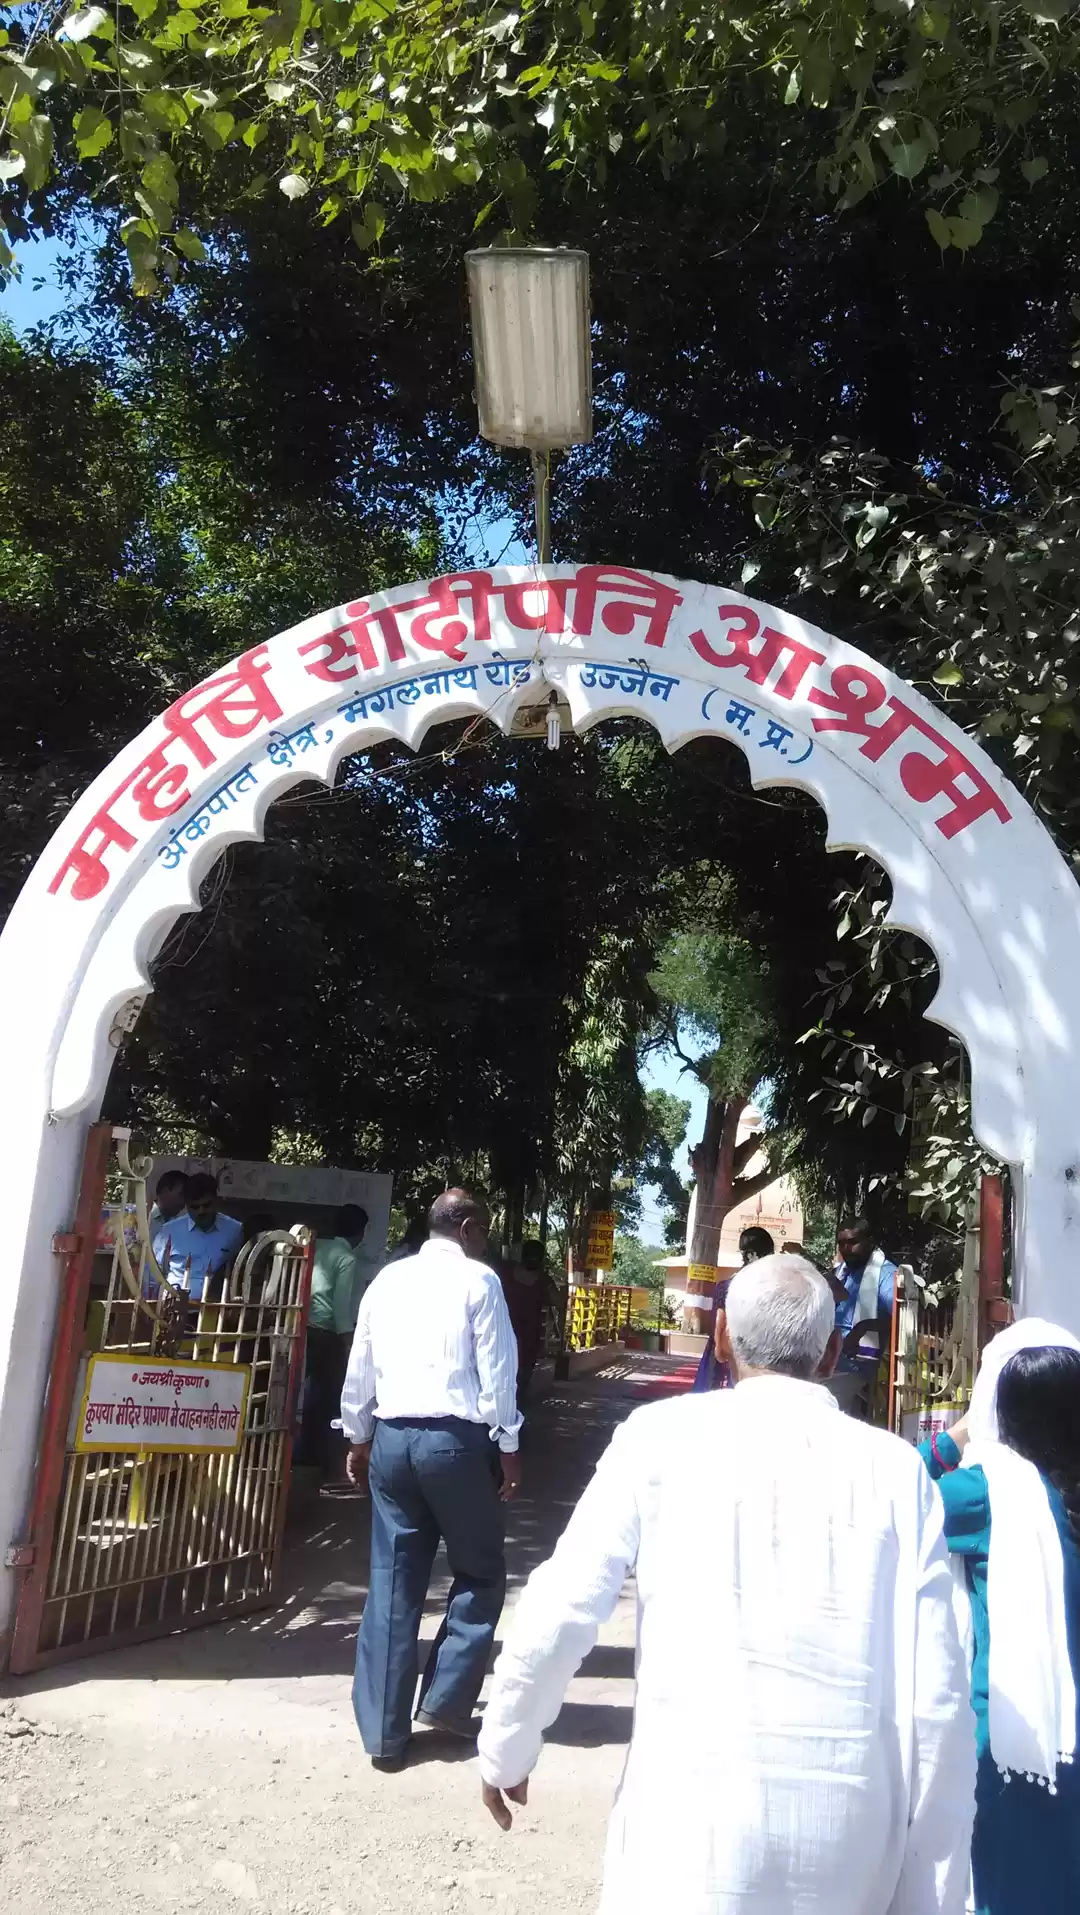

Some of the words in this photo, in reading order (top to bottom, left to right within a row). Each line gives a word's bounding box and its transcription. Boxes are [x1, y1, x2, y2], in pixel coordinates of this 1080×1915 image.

[47, 644, 284, 900] महर्षि
[297, 565, 683, 683] सांदीपनि
[688, 604, 1013, 840] आश्रम
[158, 762, 258, 869] अंकपात
[337, 664, 479, 723] मंगलनाथ
[580, 657, 680, 702] उज्जैन
[85, 1402, 115, 1434] कृपया
[116, 1397, 142, 1429] मंदिर
